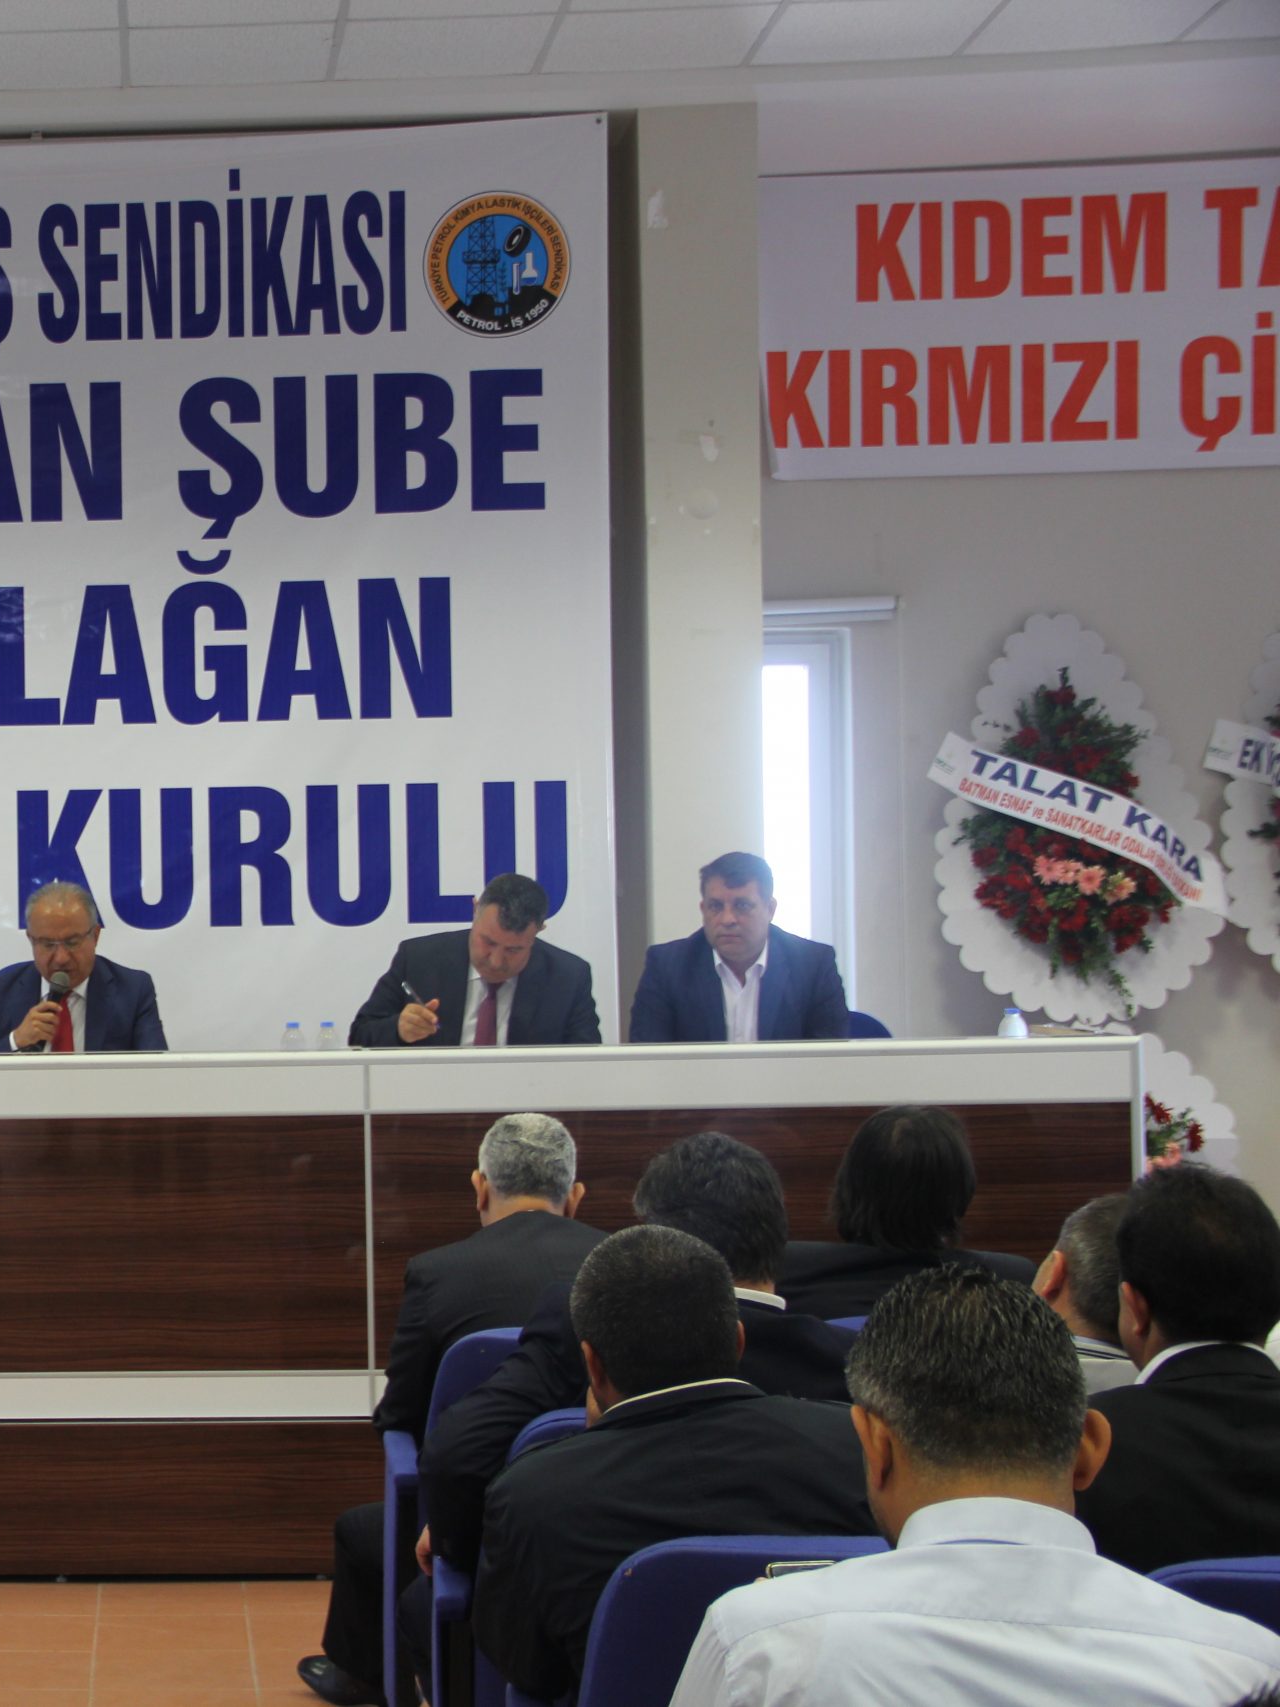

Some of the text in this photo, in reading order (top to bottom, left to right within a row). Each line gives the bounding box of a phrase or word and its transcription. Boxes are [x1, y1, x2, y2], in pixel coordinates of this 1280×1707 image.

[38, 168, 407, 343] SENDİKASI
[431, 222, 456, 260] PETROL
[856, 191, 1167, 302] KIDEM
[456, 309, 501, 330] PETROL
[524, 299, 549, 320] 1950
[766, 340, 1139, 449] KIRMIZI
[178, 369, 546, 540] ŞUBE
[959, 778, 999, 805] BATMAN
[998, 792, 1032, 814] ESNAF
[971, 749, 1114, 814] TALAT
[1123, 805, 1203, 882] KARA
[17, 780, 568, 931] KURULU
